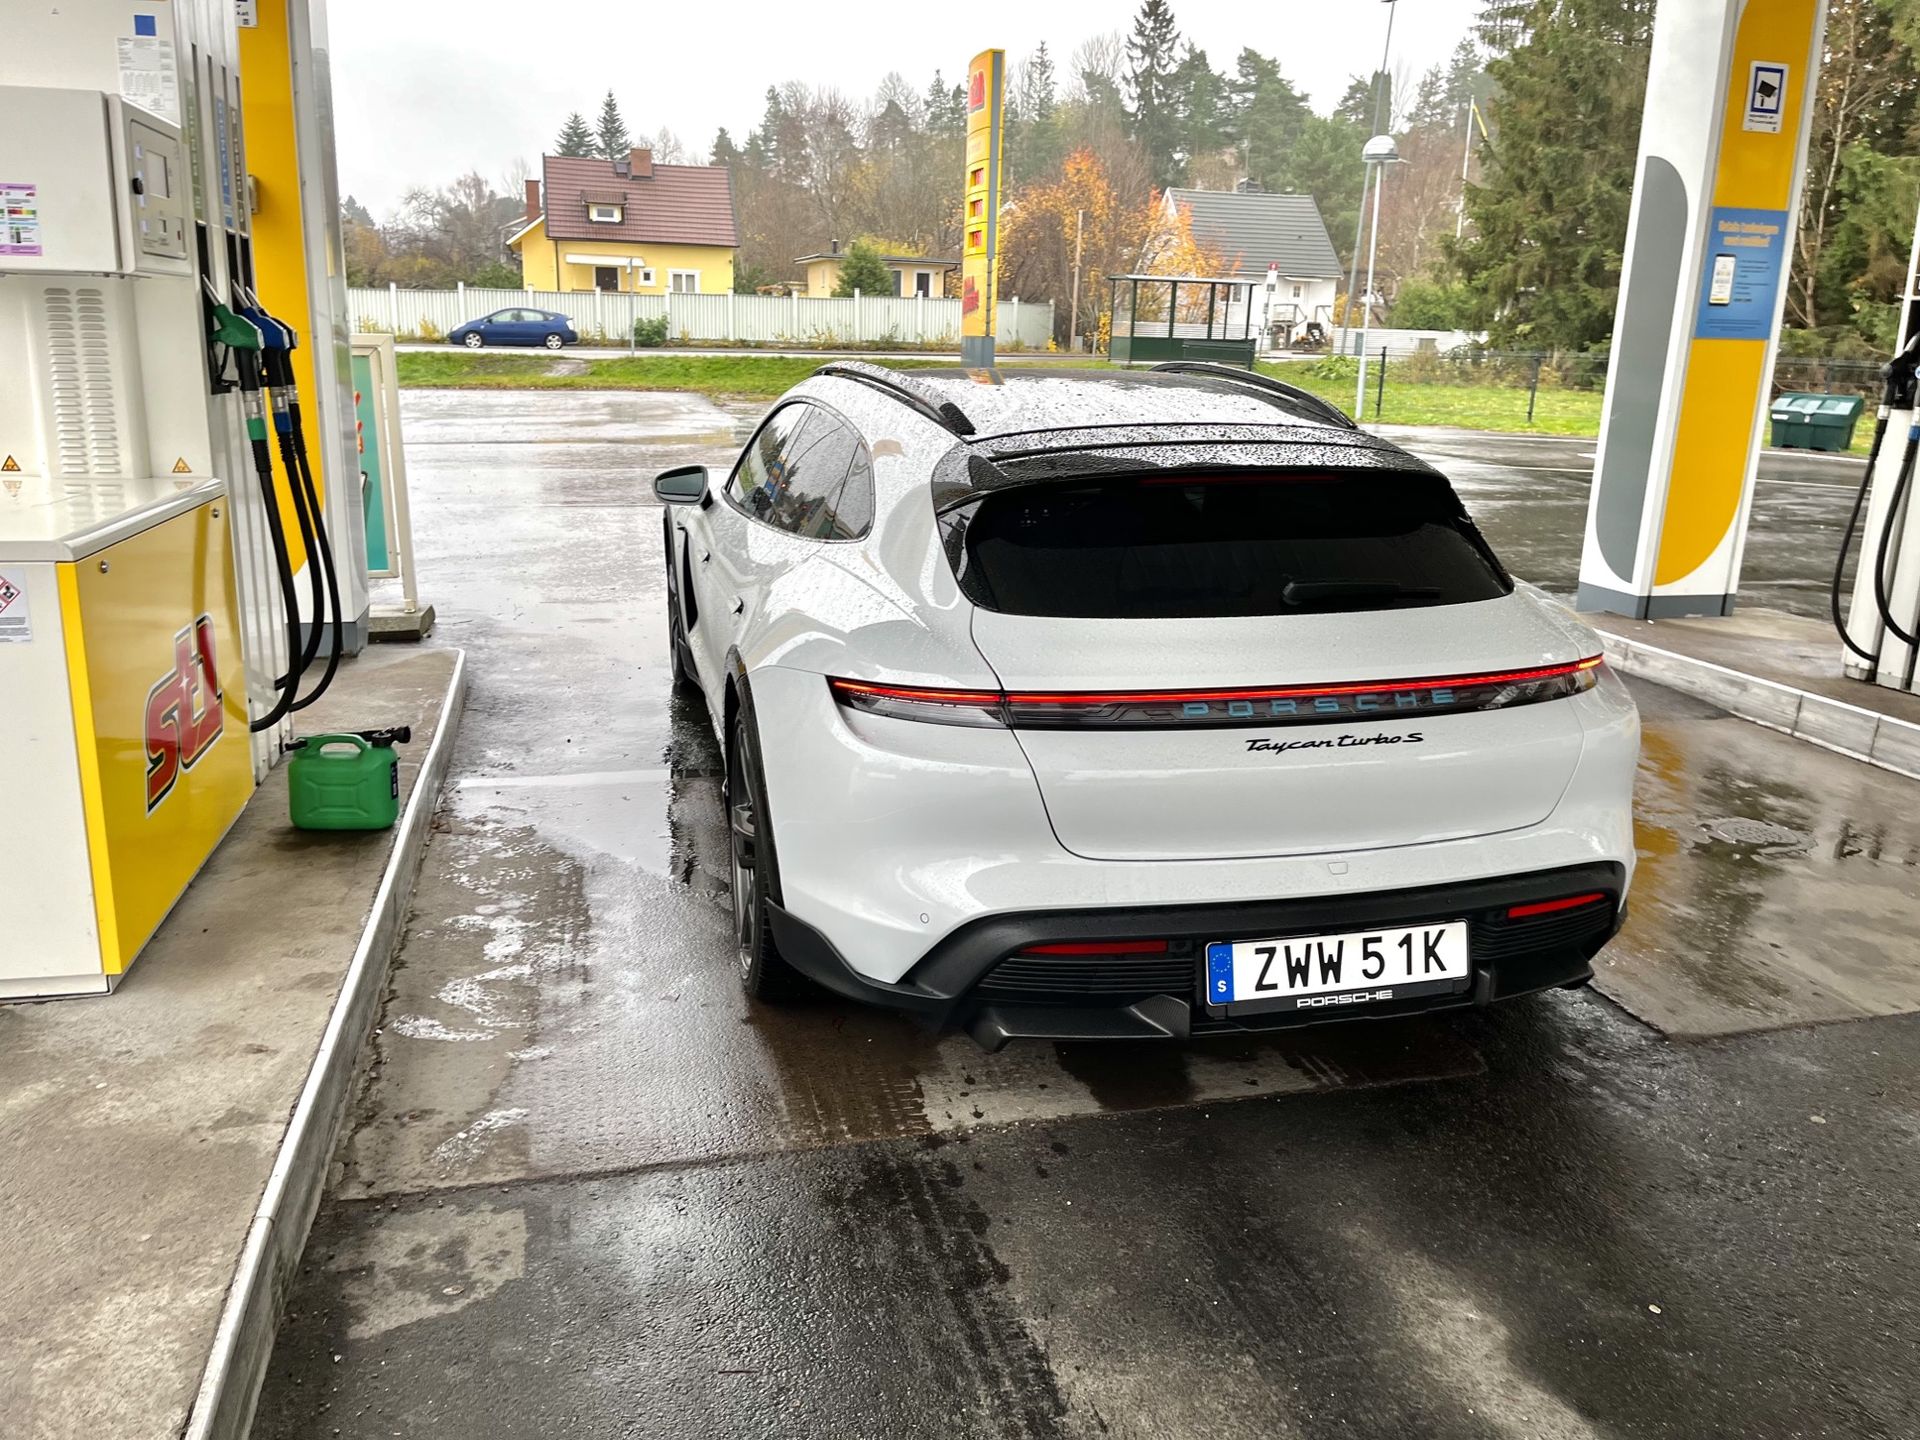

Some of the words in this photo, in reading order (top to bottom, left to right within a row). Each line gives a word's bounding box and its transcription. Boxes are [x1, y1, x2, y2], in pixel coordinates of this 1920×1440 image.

[1182, 688, 1455, 719] PORSCHE
[1245, 738, 1334, 755] Taycan
[1337, 733, 1402, 748] turbo
[1402, 732, 1424, 743] S
[1254, 940, 1344, 992] ZWW
[1362, 929, 1447, 980] 51K
[1217, 980, 1227, 993] S
[1296, 989, 1393, 1008] PORSCHE
